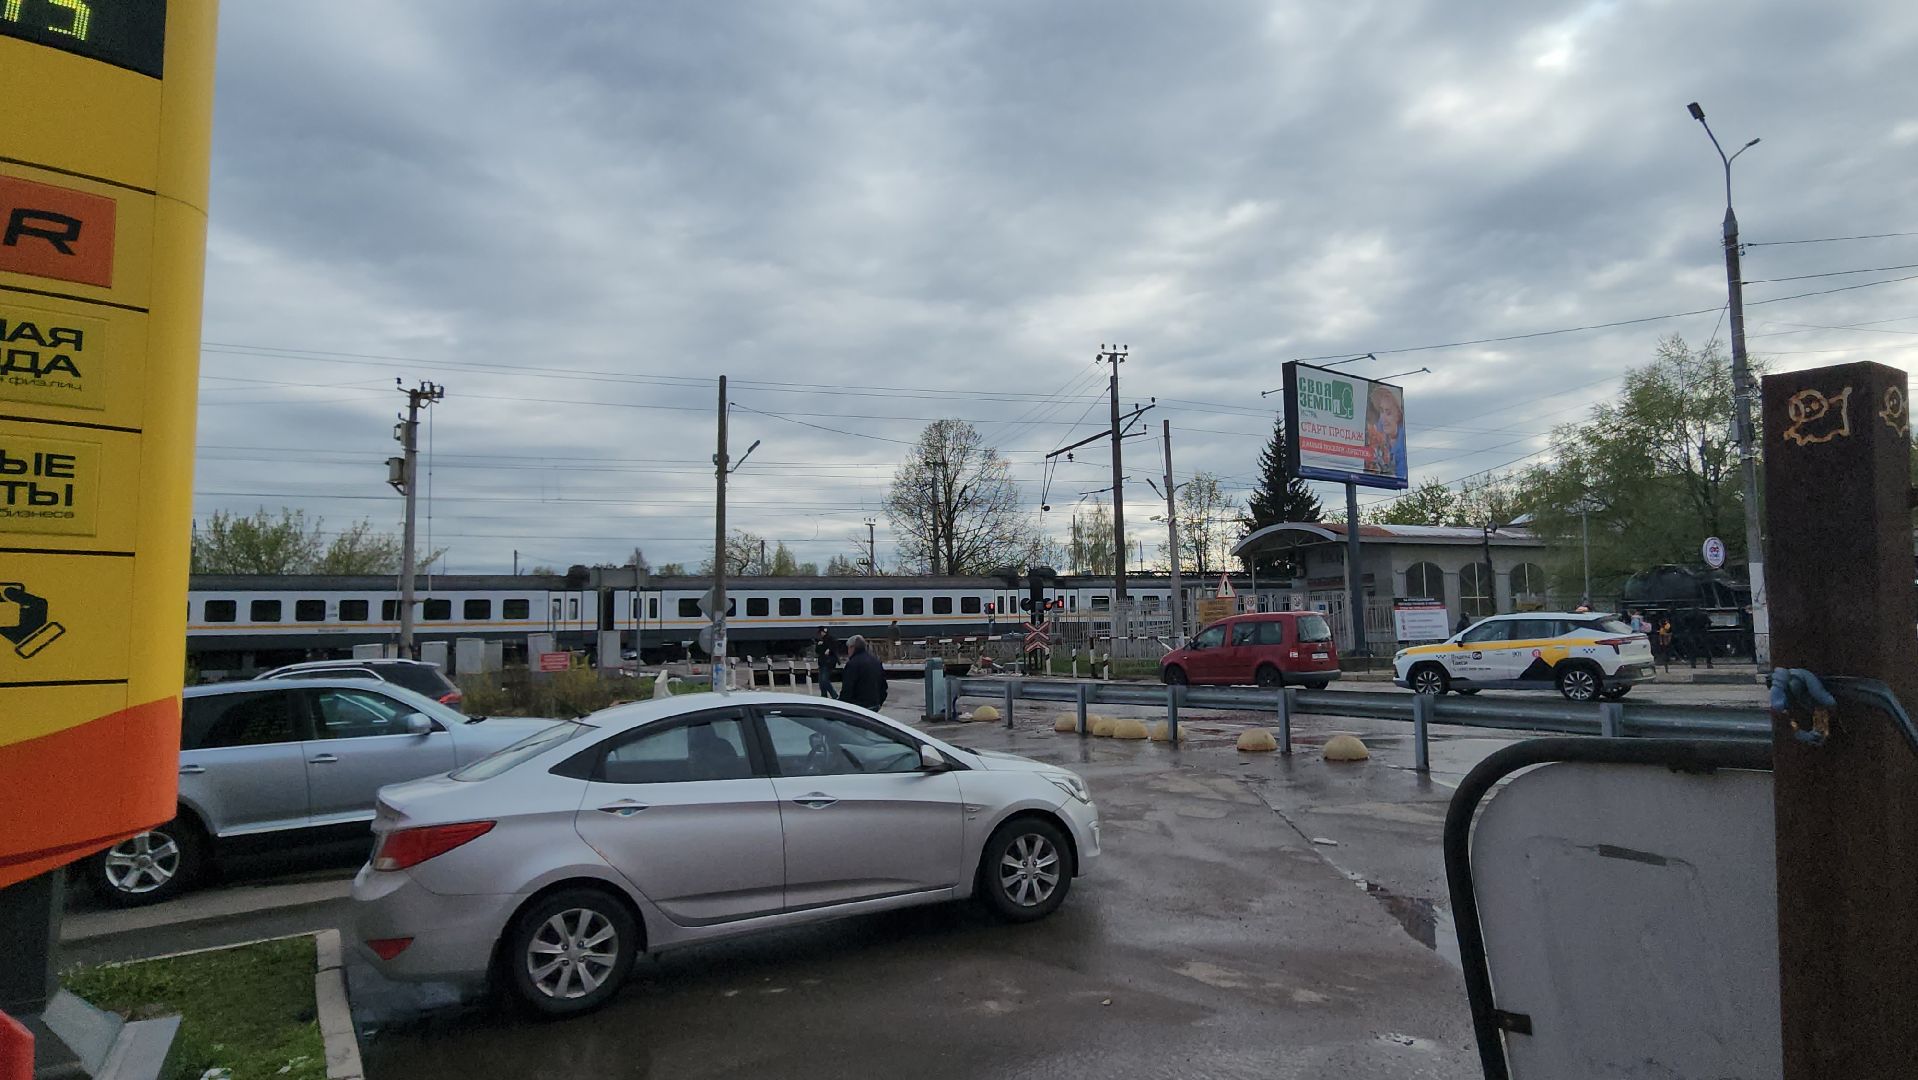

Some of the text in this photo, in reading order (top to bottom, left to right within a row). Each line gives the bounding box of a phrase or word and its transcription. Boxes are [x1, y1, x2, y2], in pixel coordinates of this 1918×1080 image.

[0, 348, 82, 378] ДА
[1300, 421, 1364, 441] СТАРТ ПРОДАЖ
